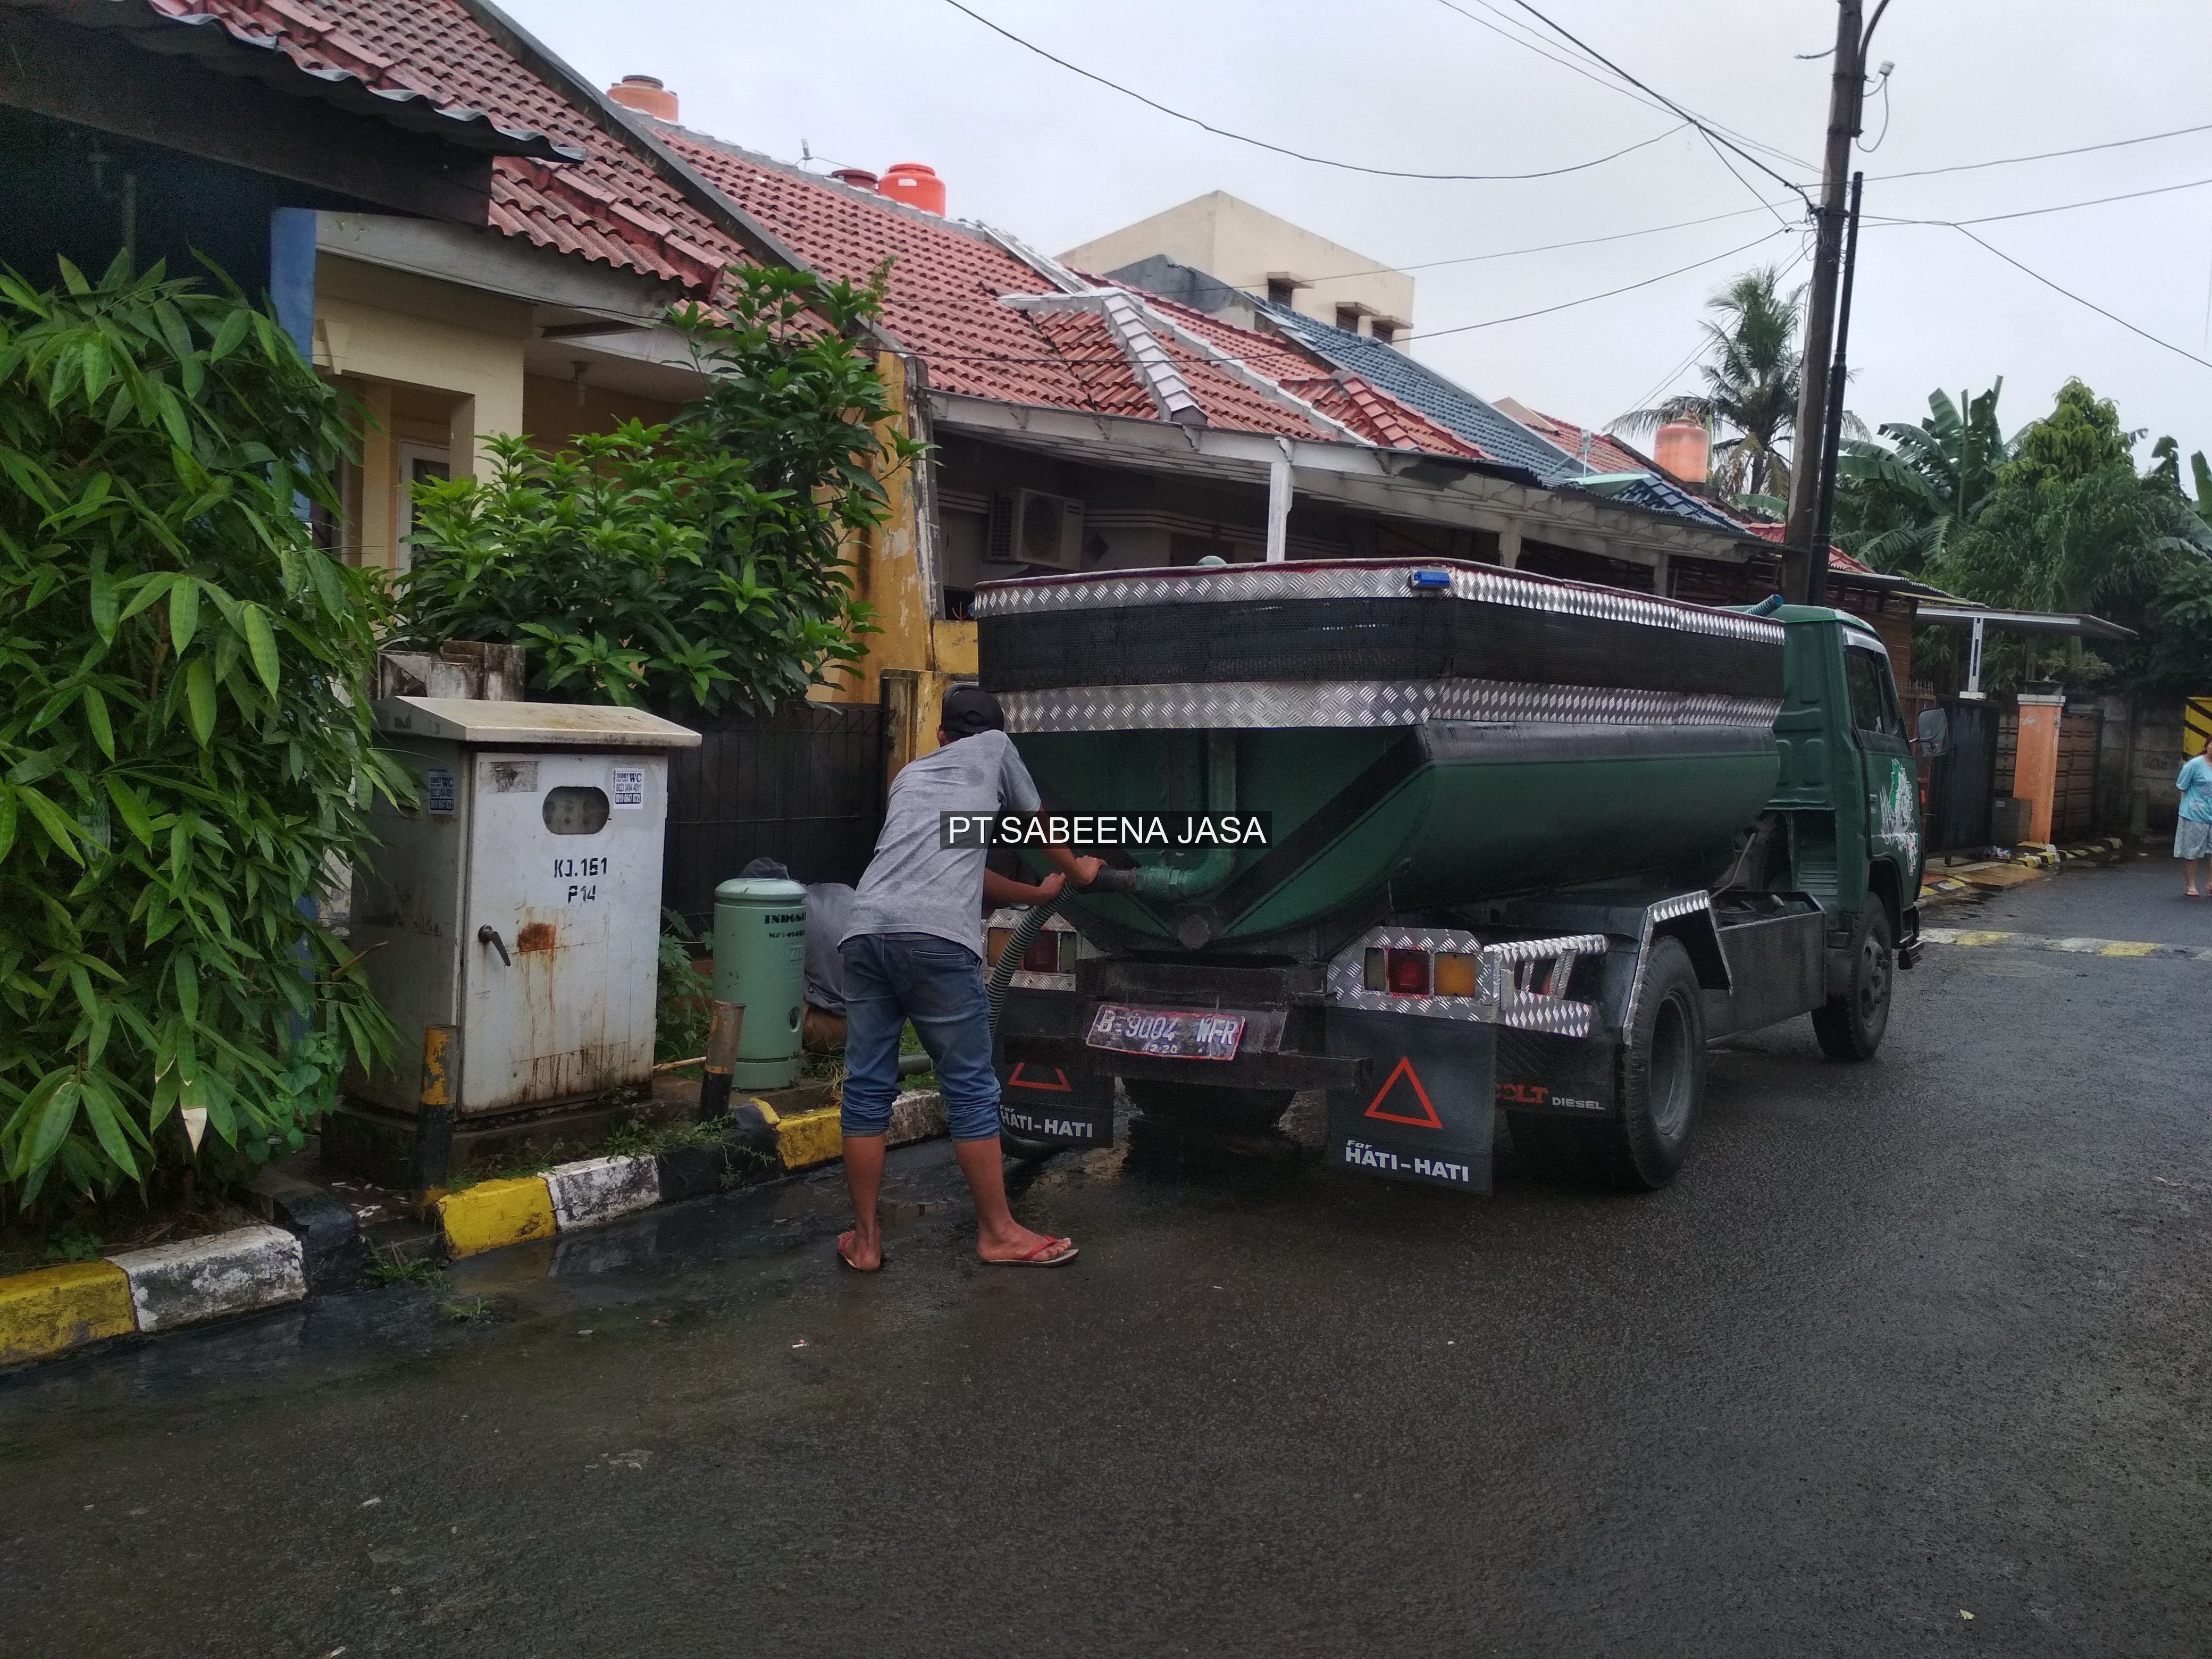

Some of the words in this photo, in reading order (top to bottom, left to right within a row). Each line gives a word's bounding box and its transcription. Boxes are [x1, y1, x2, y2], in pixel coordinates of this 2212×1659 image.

[441, 777, 453, 787] WC
[630, 773, 641, 783] WC
[1552, 1096, 1605, 1110] DIESEL
[1000, 1104, 1015, 1113] For
[1347, 1139, 1372, 1149] For
[1345, 1146, 1469, 1182] HATI-HATI
